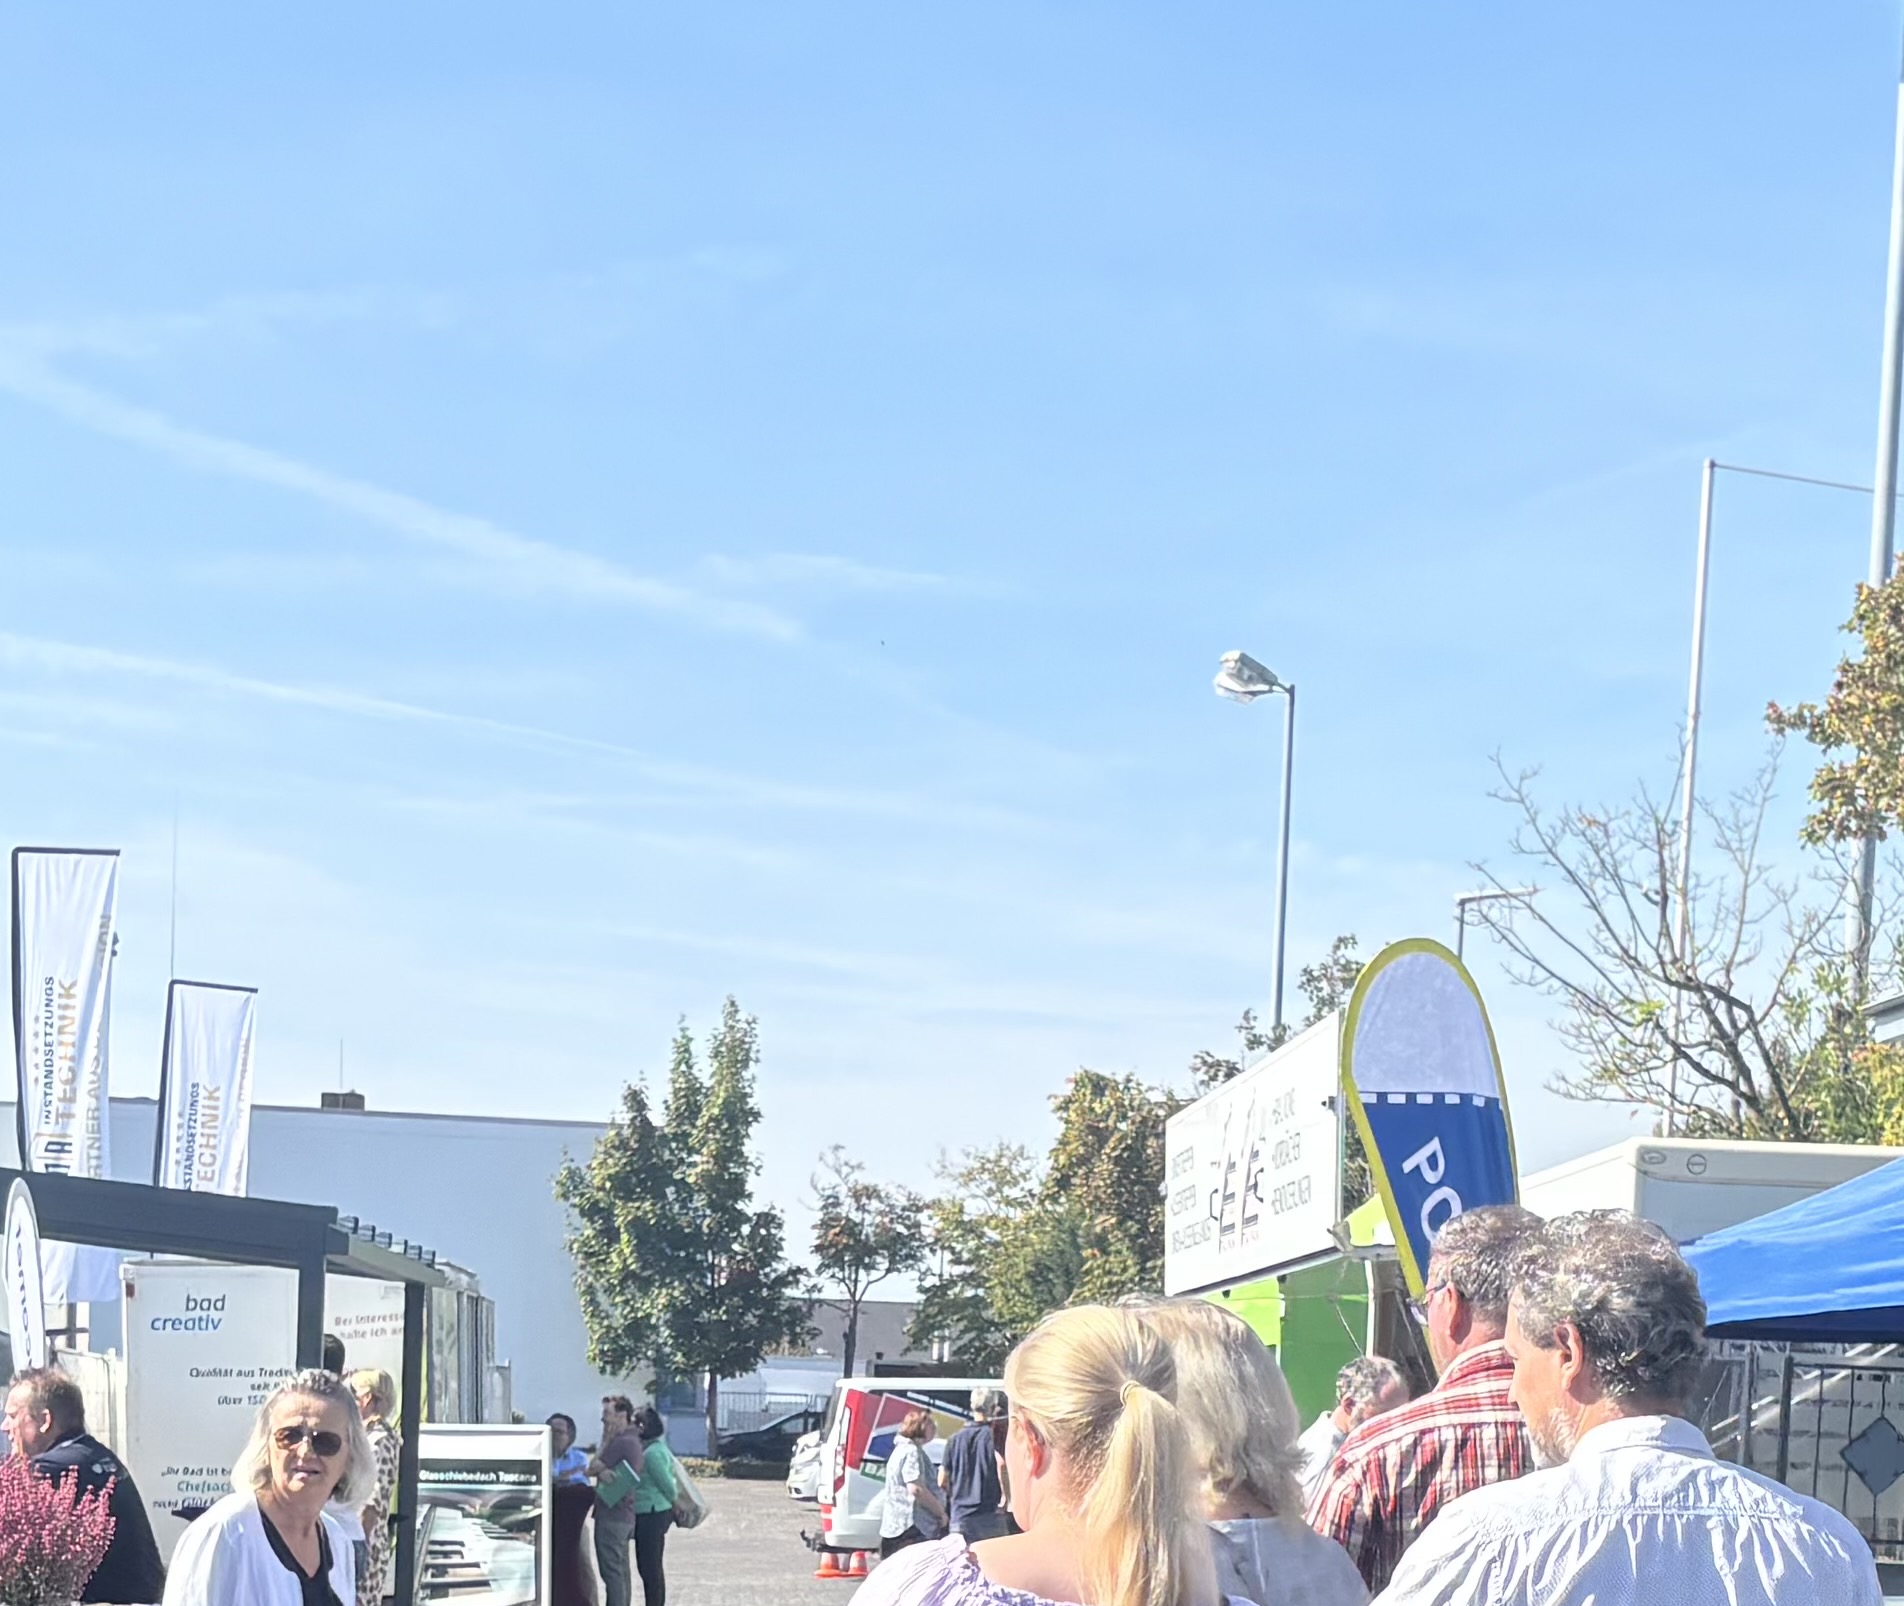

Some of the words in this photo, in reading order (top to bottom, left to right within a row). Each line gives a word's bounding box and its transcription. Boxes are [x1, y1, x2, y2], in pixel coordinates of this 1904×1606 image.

[55, 977, 78, 1126] TECHNIK
[196, 1083, 222, 1187] ECHNIK
[150, 1314, 223, 1331] creativ
[184, 1293, 227, 1312] bad
